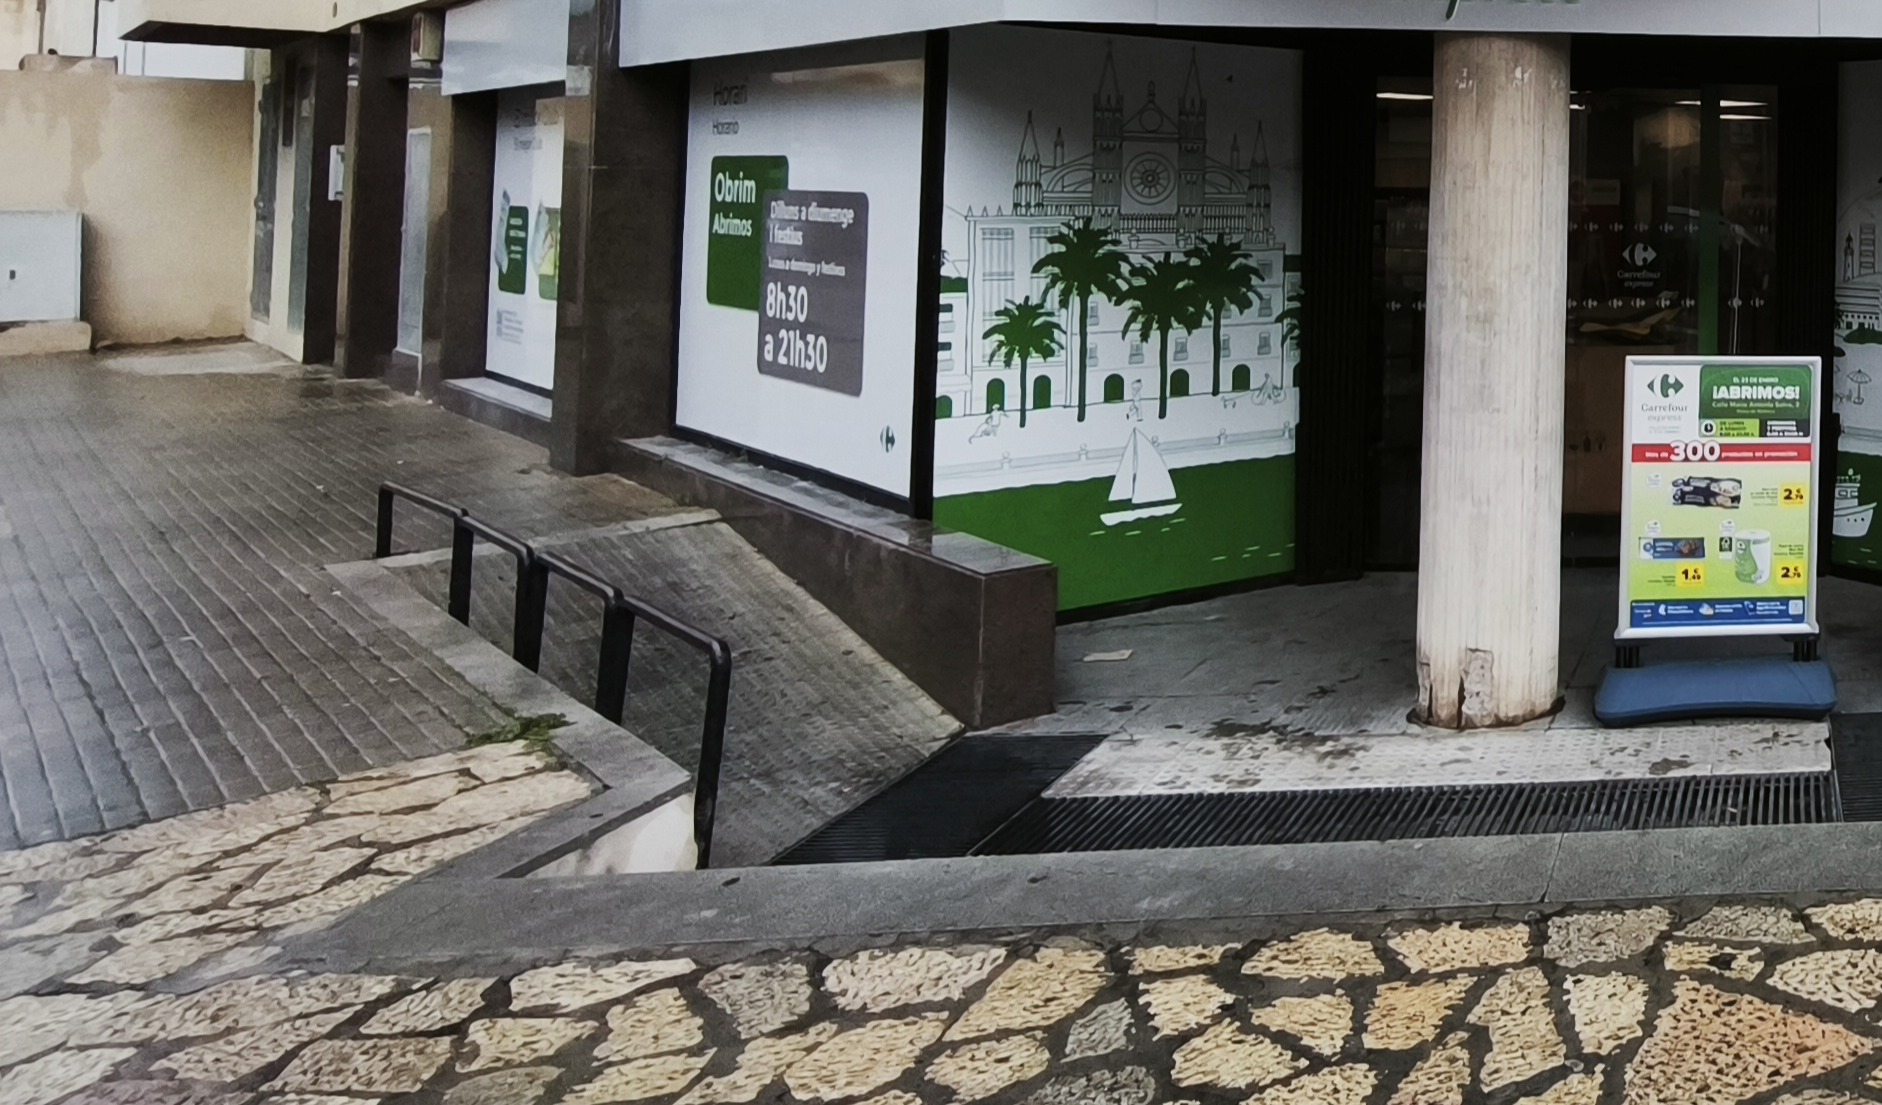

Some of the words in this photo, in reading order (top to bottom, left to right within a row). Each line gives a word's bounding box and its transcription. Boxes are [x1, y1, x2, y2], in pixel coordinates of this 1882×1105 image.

[714, 171, 756, 204] Obrim
[712, 213, 753, 238] Abrimos
[765, 281, 808, 323] 8h30
[763, 333, 774, 363] a
[777, 332, 828, 373] 21h30
[1712, 385, 1800, 400] ¡ABRIMOS!
[1641, 403, 1688, 412] Carrefour
[1669, 440, 1721, 462] 300
